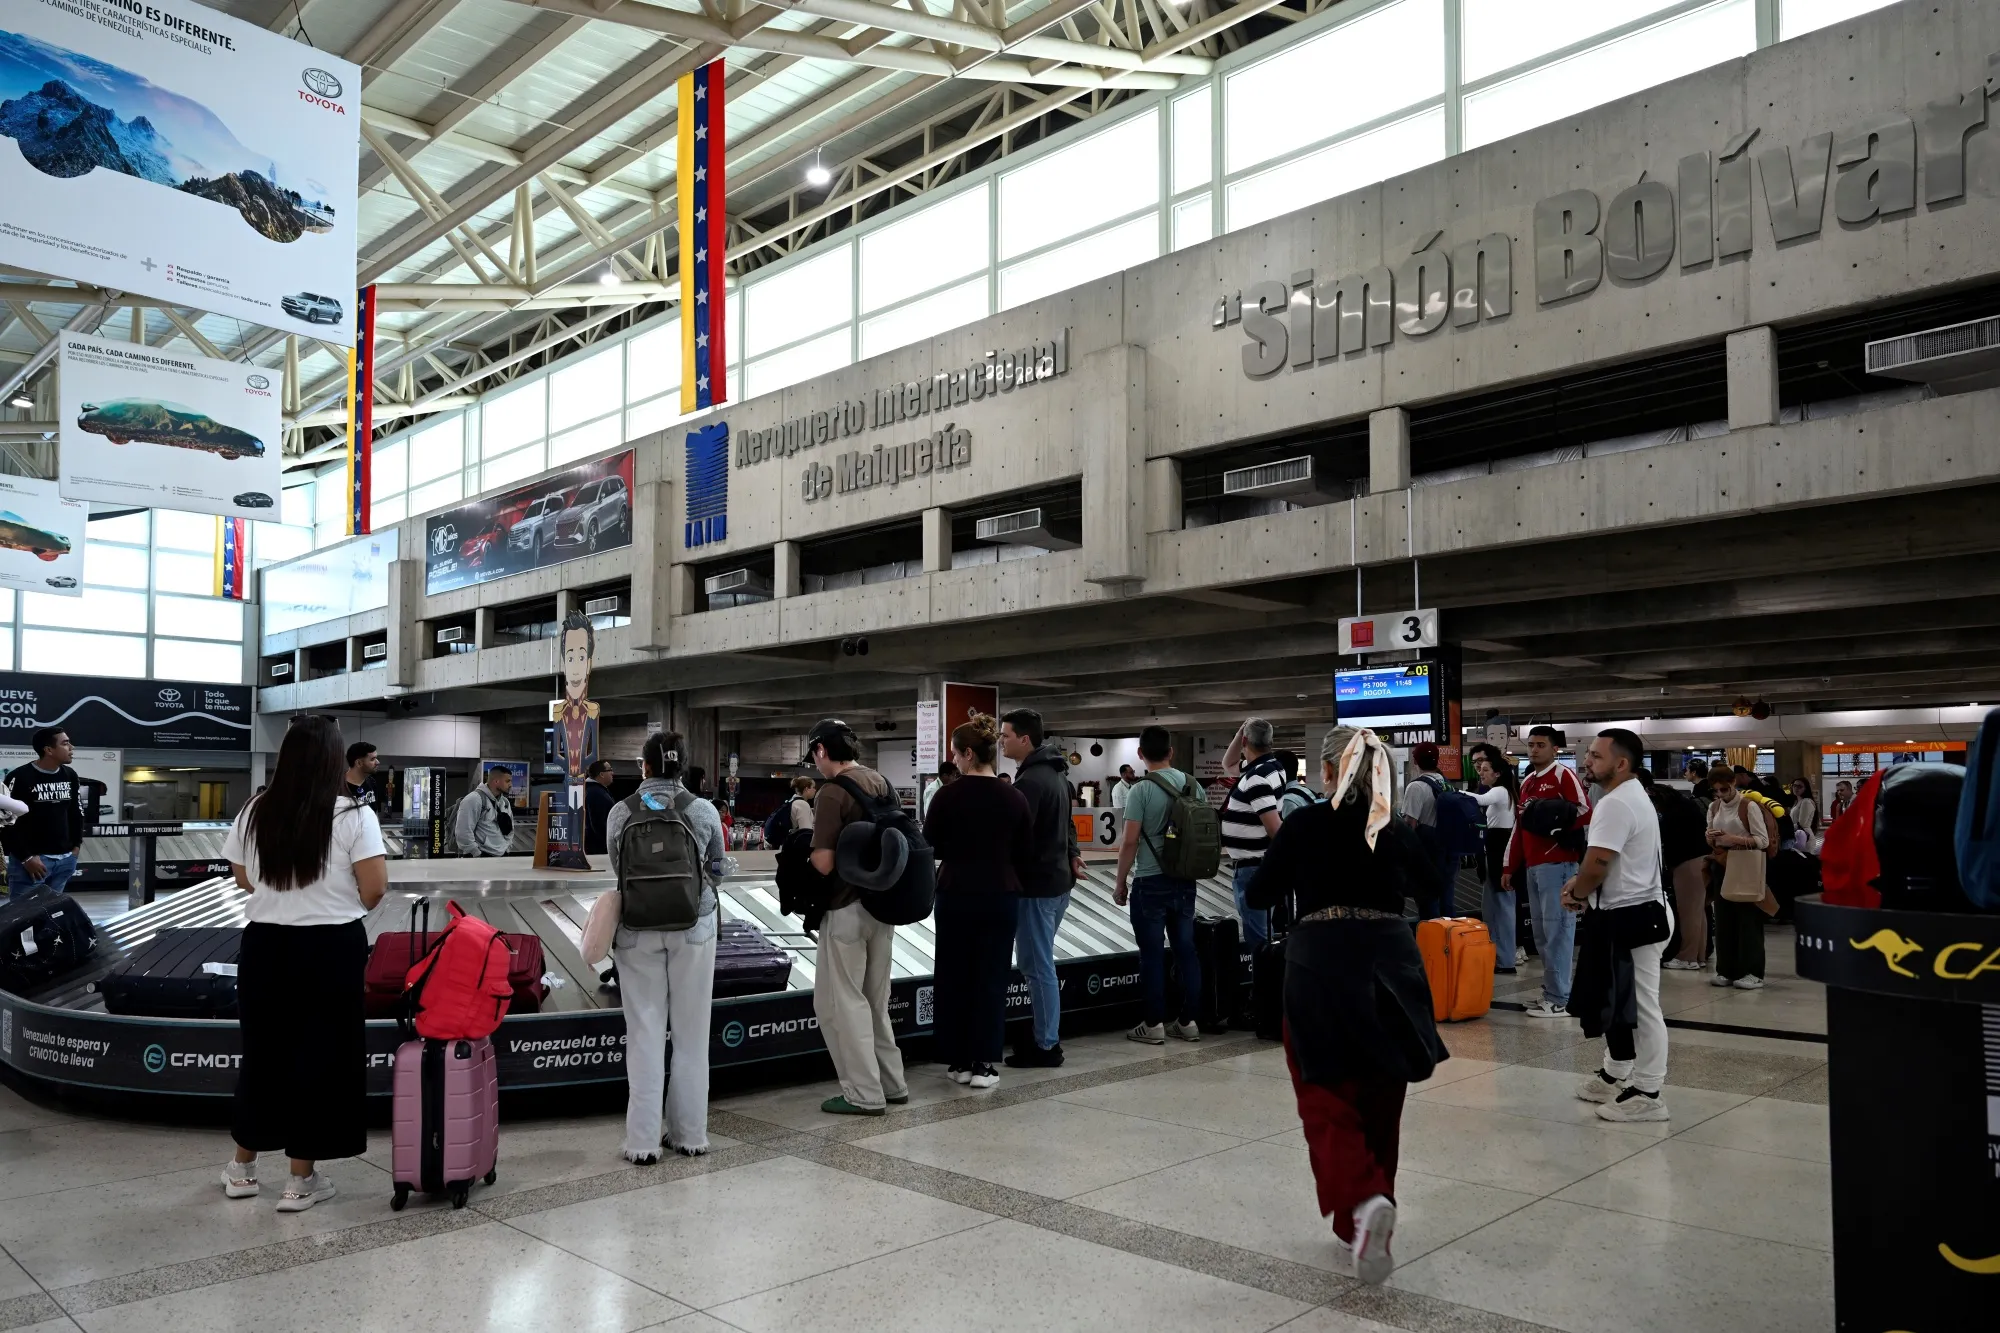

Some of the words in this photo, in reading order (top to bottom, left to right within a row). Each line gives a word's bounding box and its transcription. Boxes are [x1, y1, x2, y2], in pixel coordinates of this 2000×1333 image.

[85, 11, 96, 23] DE
[97, 15, 144, 40] VENEZUELA.
[101, 0, 142, 15] MINO
[145, 6, 161, 22] ES
[164, 13, 236, 51] DIFERENTE.
[102, 7, 169, 38] CARACTERÍSTICAS
[170, 33, 212, 55] ESPECIALES
[297, 90, 346, 116] TOYOTA
[176, 265, 203, 277] Respaldo
[68, 342, 86, 351] CADA
[105, 348, 123, 358] CADA
[124, 352, 151, 363] CAMINO
[151, 356, 160, 364] ES
[160, 358, 196, 371] DIFERENTE.
[244, 387, 272, 398] TOYOTA
[735, 397, 866, 469] Aeropuerto
[869, 326, 1070, 431] Internacional
[801, 460, 834, 502] de
[835, 421, 973, 498] Maiquetía
[60, 500, 82, 508] TOYOTA
[684, 514, 728, 549] IAIM
[1401, 615, 1422, 643] 3
[1415, 664, 1429, 676] 03
[1372, 681, 1388, 689] 7006
[1395, 679, 1413, 687] 11:48
[204, 690, 226, 698] Todo
[1363, 688, 1392, 697] BOGOTA
[0, 702, 37, 715] CON
[154, 701, 185, 709] TOYOTA
[213, 704, 241, 712] mueve
[214, 698, 230, 706] que
[1403, 729, 1436, 745] IAIM
[31, 781, 72, 793] ANYWHERE
[37, 790, 71, 801] ANYTIME
[101, 825, 129, 836] IAIM
[548, 827, 568, 841] VIAJE
[1099, 810, 1117, 846] 3
[207, 863, 229, 872] Plus
[1060, 979, 1066, 991] y
[748, 1017, 820, 1038] CFMOTO
[22, 1026, 56, 1045] Venezuela
[57, 1034, 66, 1047] te
[66, 1037, 101, 1052] espera
[102, 1041, 110, 1056] y
[510, 1035, 597, 1053] Venezuela
[600, 1034, 616, 1047] te
[29, 1045, 59, 1063] CFMOTO
[60, 1052, 69, 1065] te
[70, 1053, 95, 1068] lleva
[533, 1051, 604, 1069] CFMOTO
[607, 1050, 622, 1063] te
